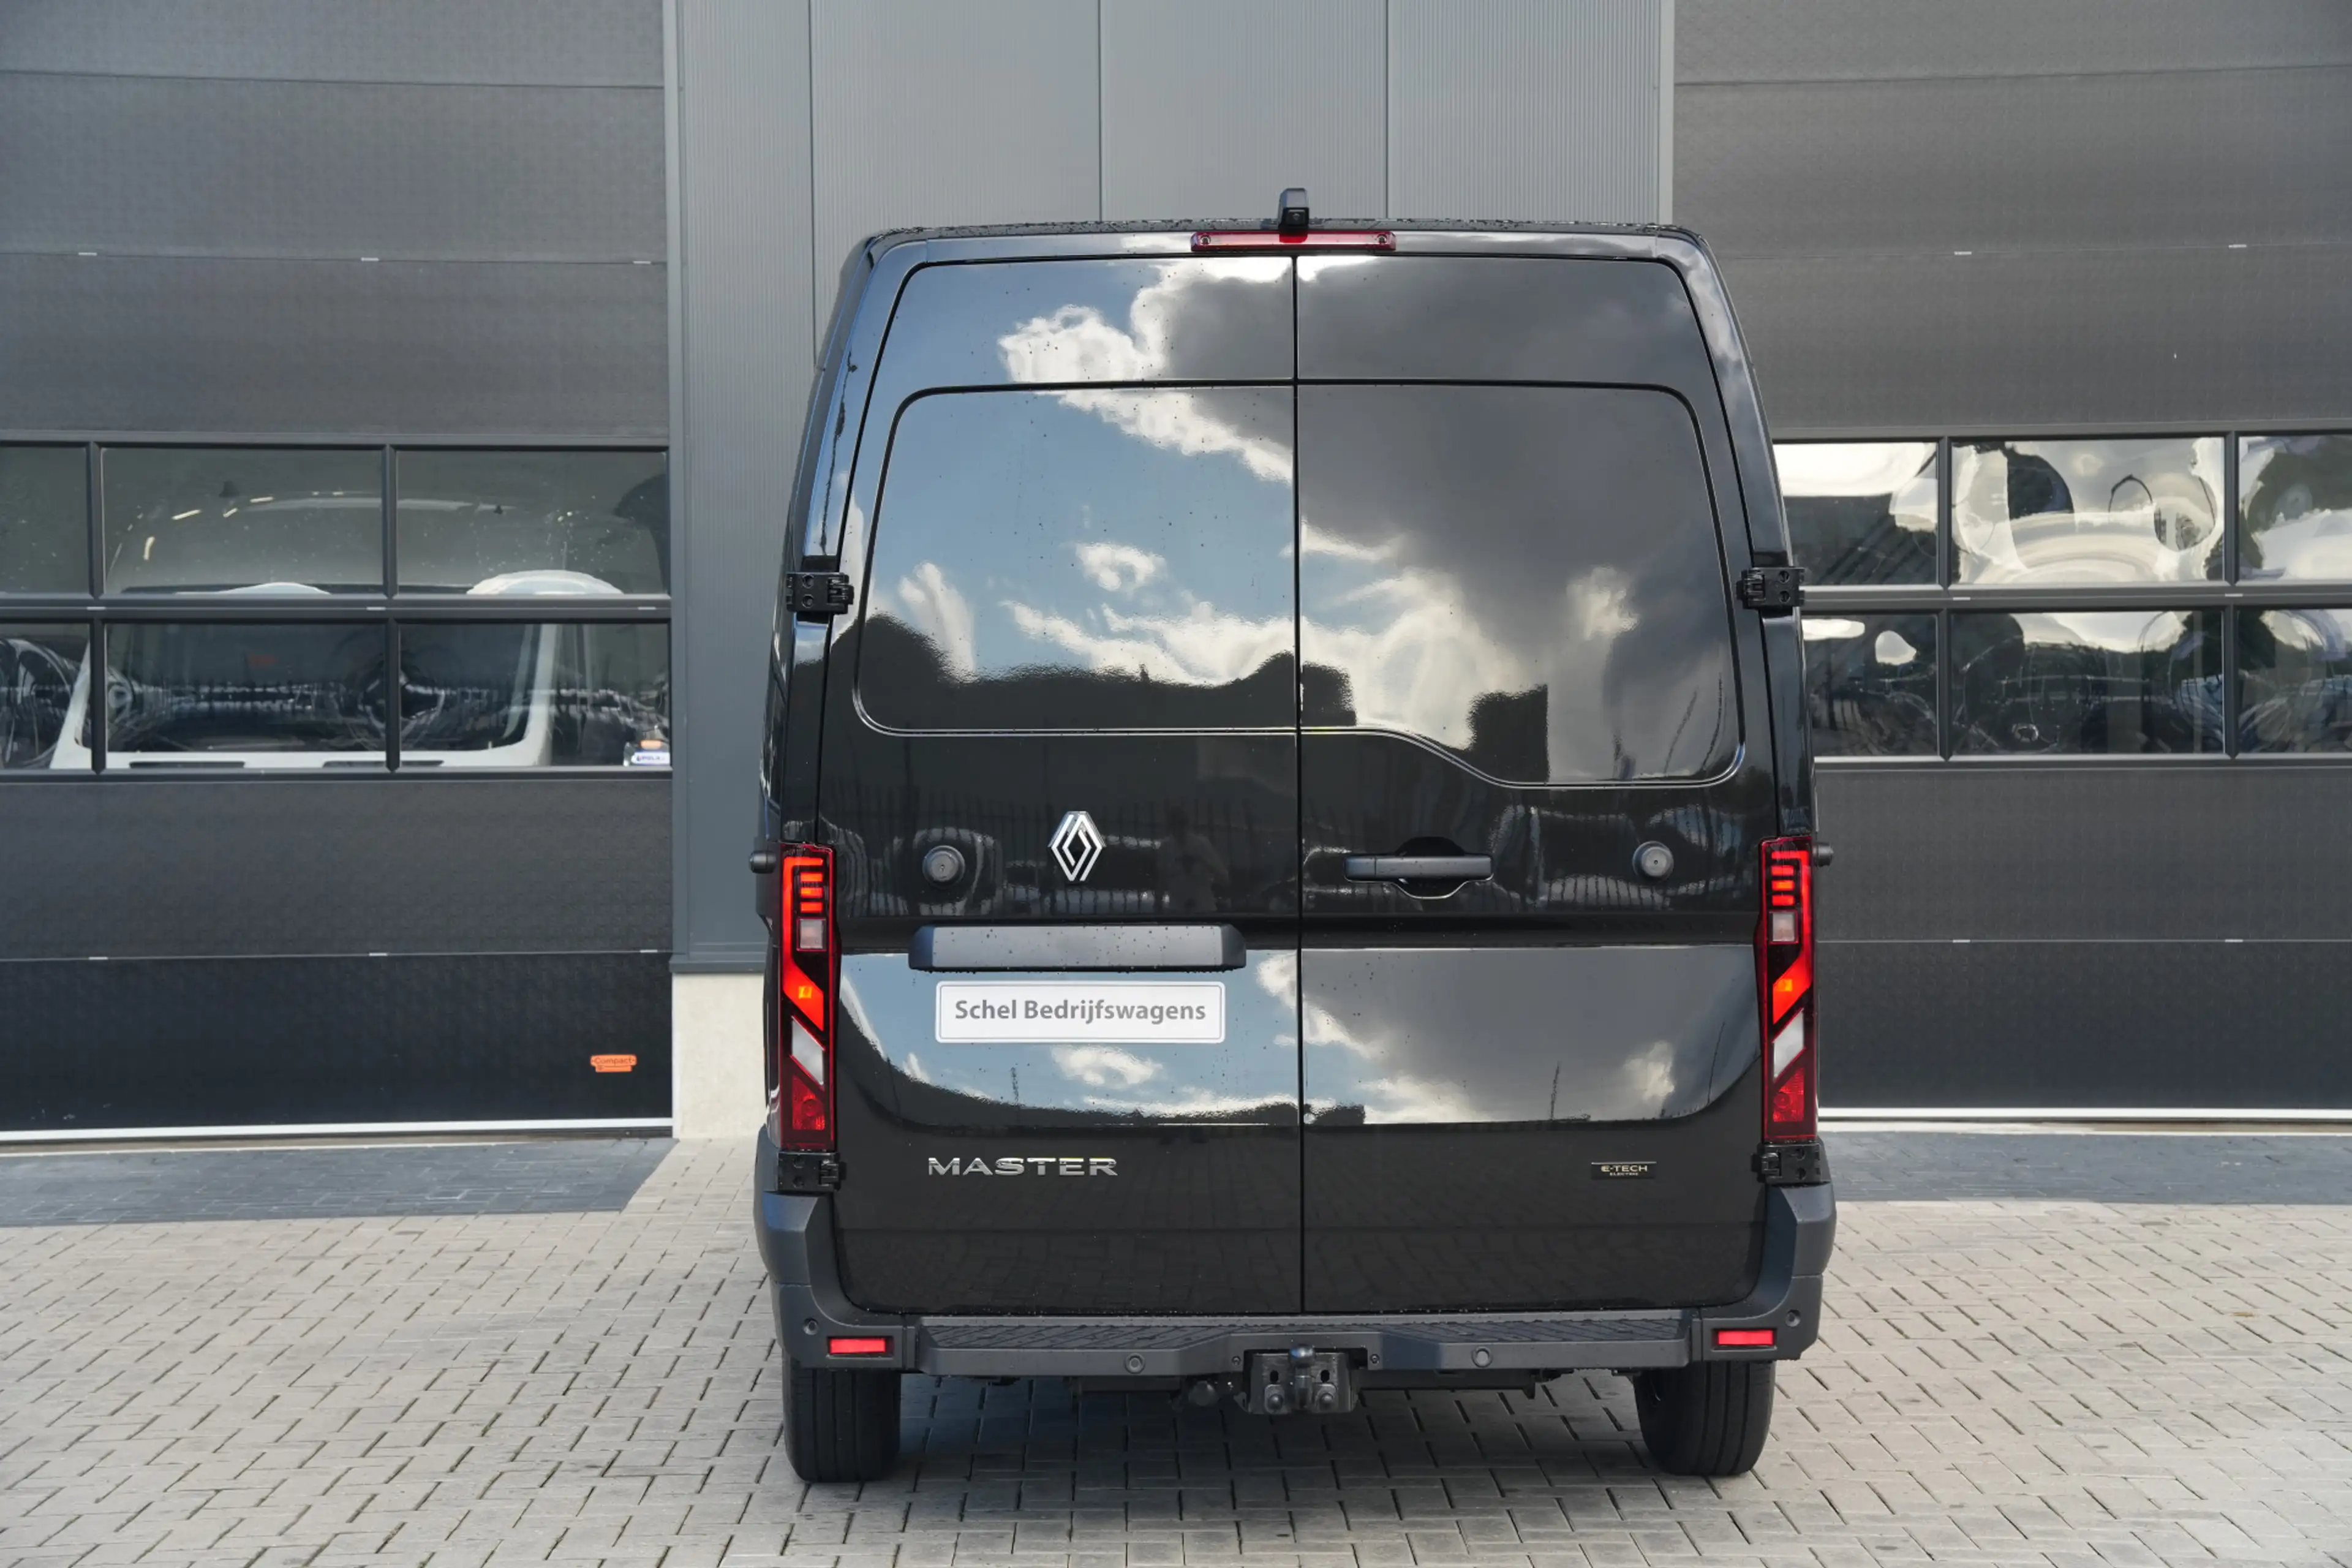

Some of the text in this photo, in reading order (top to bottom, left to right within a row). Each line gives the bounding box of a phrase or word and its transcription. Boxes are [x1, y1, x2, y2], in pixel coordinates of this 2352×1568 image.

[955, 999, 1206, 1025] Schel Bedrijfswagens
[928, 1156, 1118, 1176] MASTER
